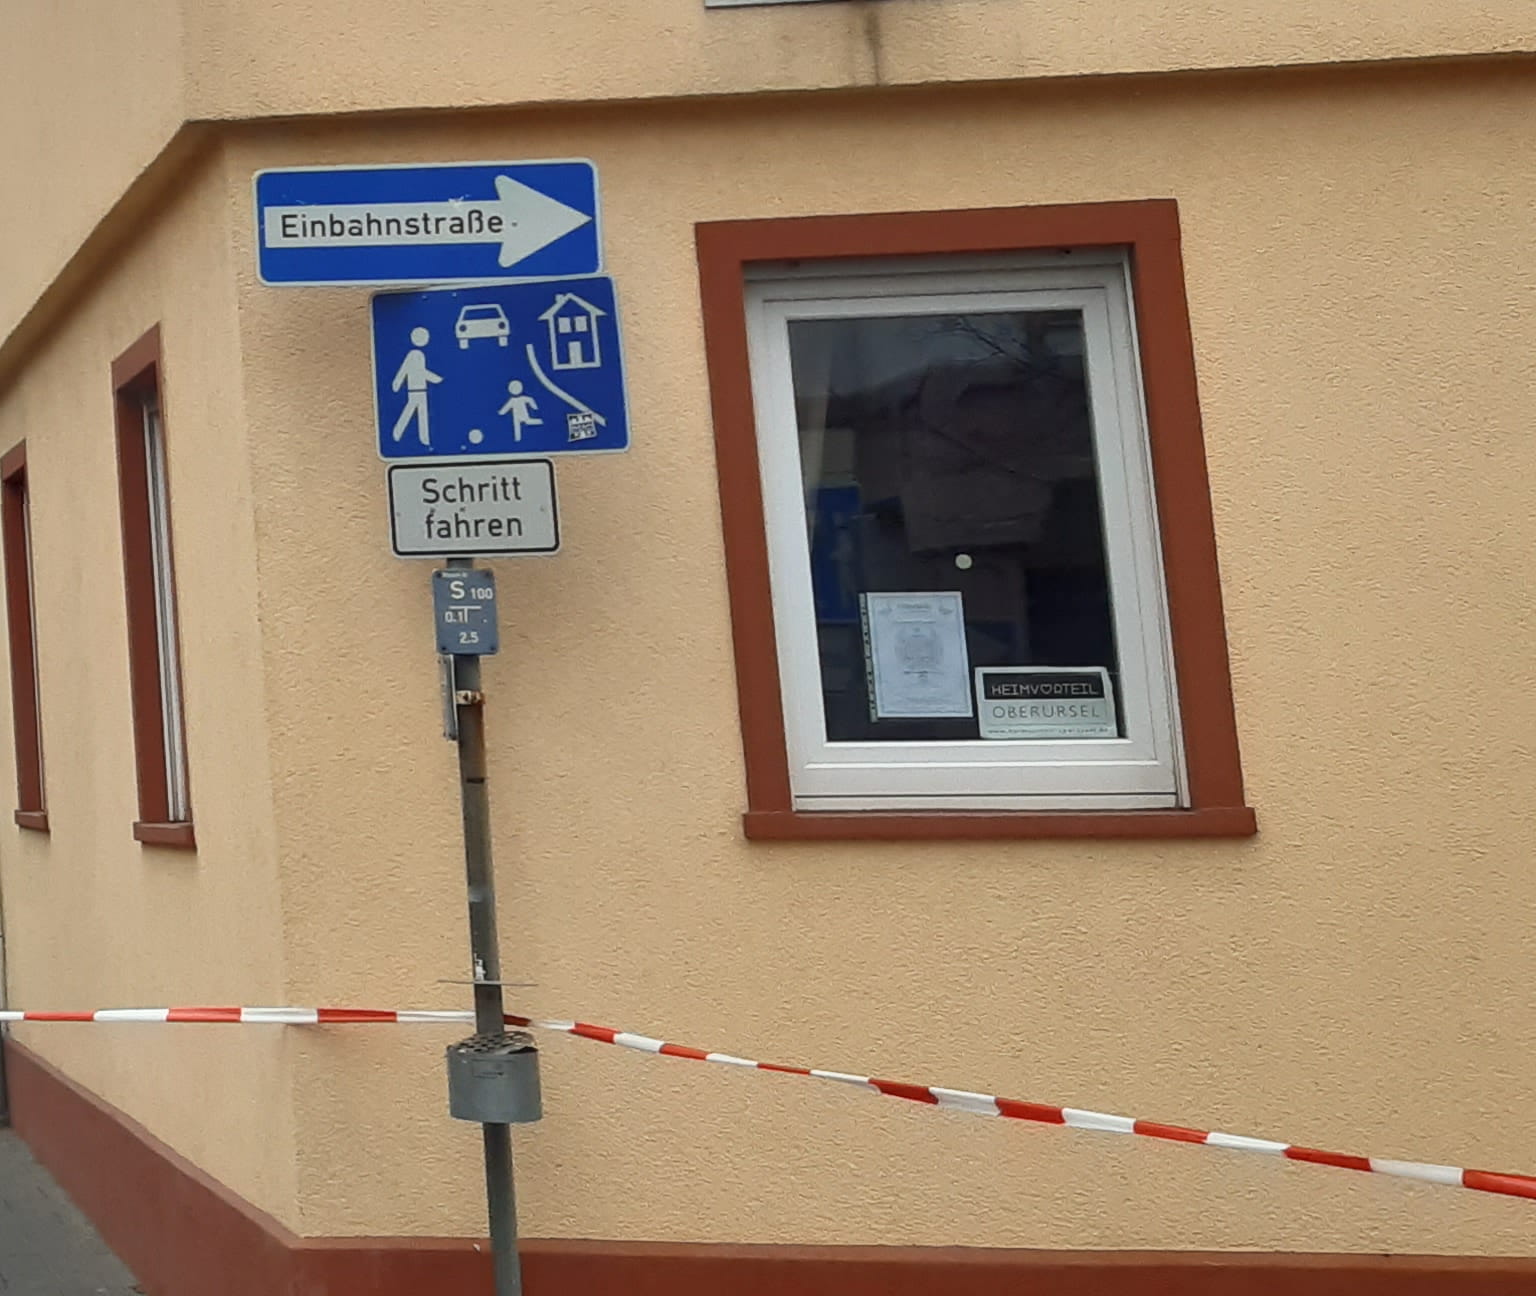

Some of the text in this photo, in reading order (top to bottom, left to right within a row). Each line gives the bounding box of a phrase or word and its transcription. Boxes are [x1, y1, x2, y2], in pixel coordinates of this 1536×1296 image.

[280, 209, 504, 238] Einbahnstraße
[421, 475, 522, 504] Schritt
[425, 512, 523, 539] fahren
[449, 580, 494, 600] S 100
[992, 704, 1101, 719] OBERURSEL
